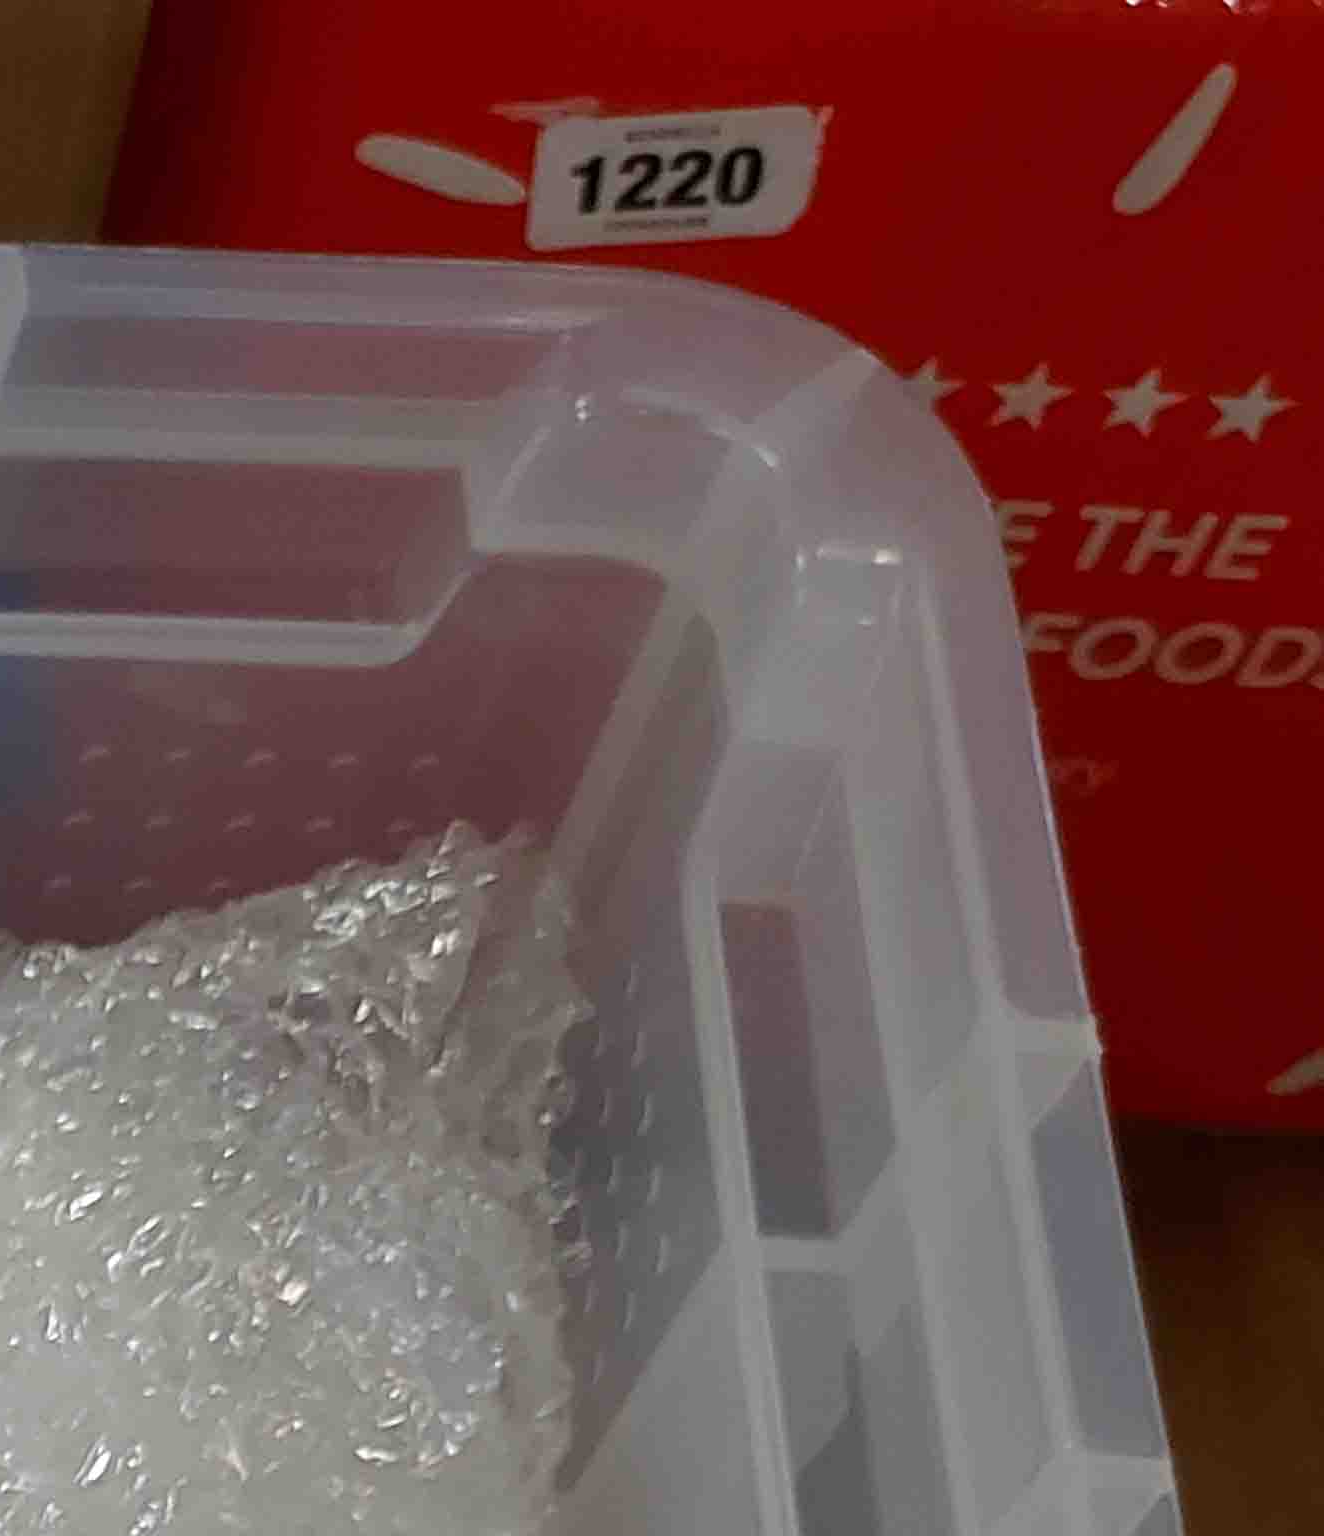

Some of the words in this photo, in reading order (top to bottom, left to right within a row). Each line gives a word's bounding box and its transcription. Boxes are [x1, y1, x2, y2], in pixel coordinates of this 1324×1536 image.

[569, 145, 765, 216] 1220
[1074, 502, 1291, 581] THE
[1021, 611, 1324, 690] FOOD
